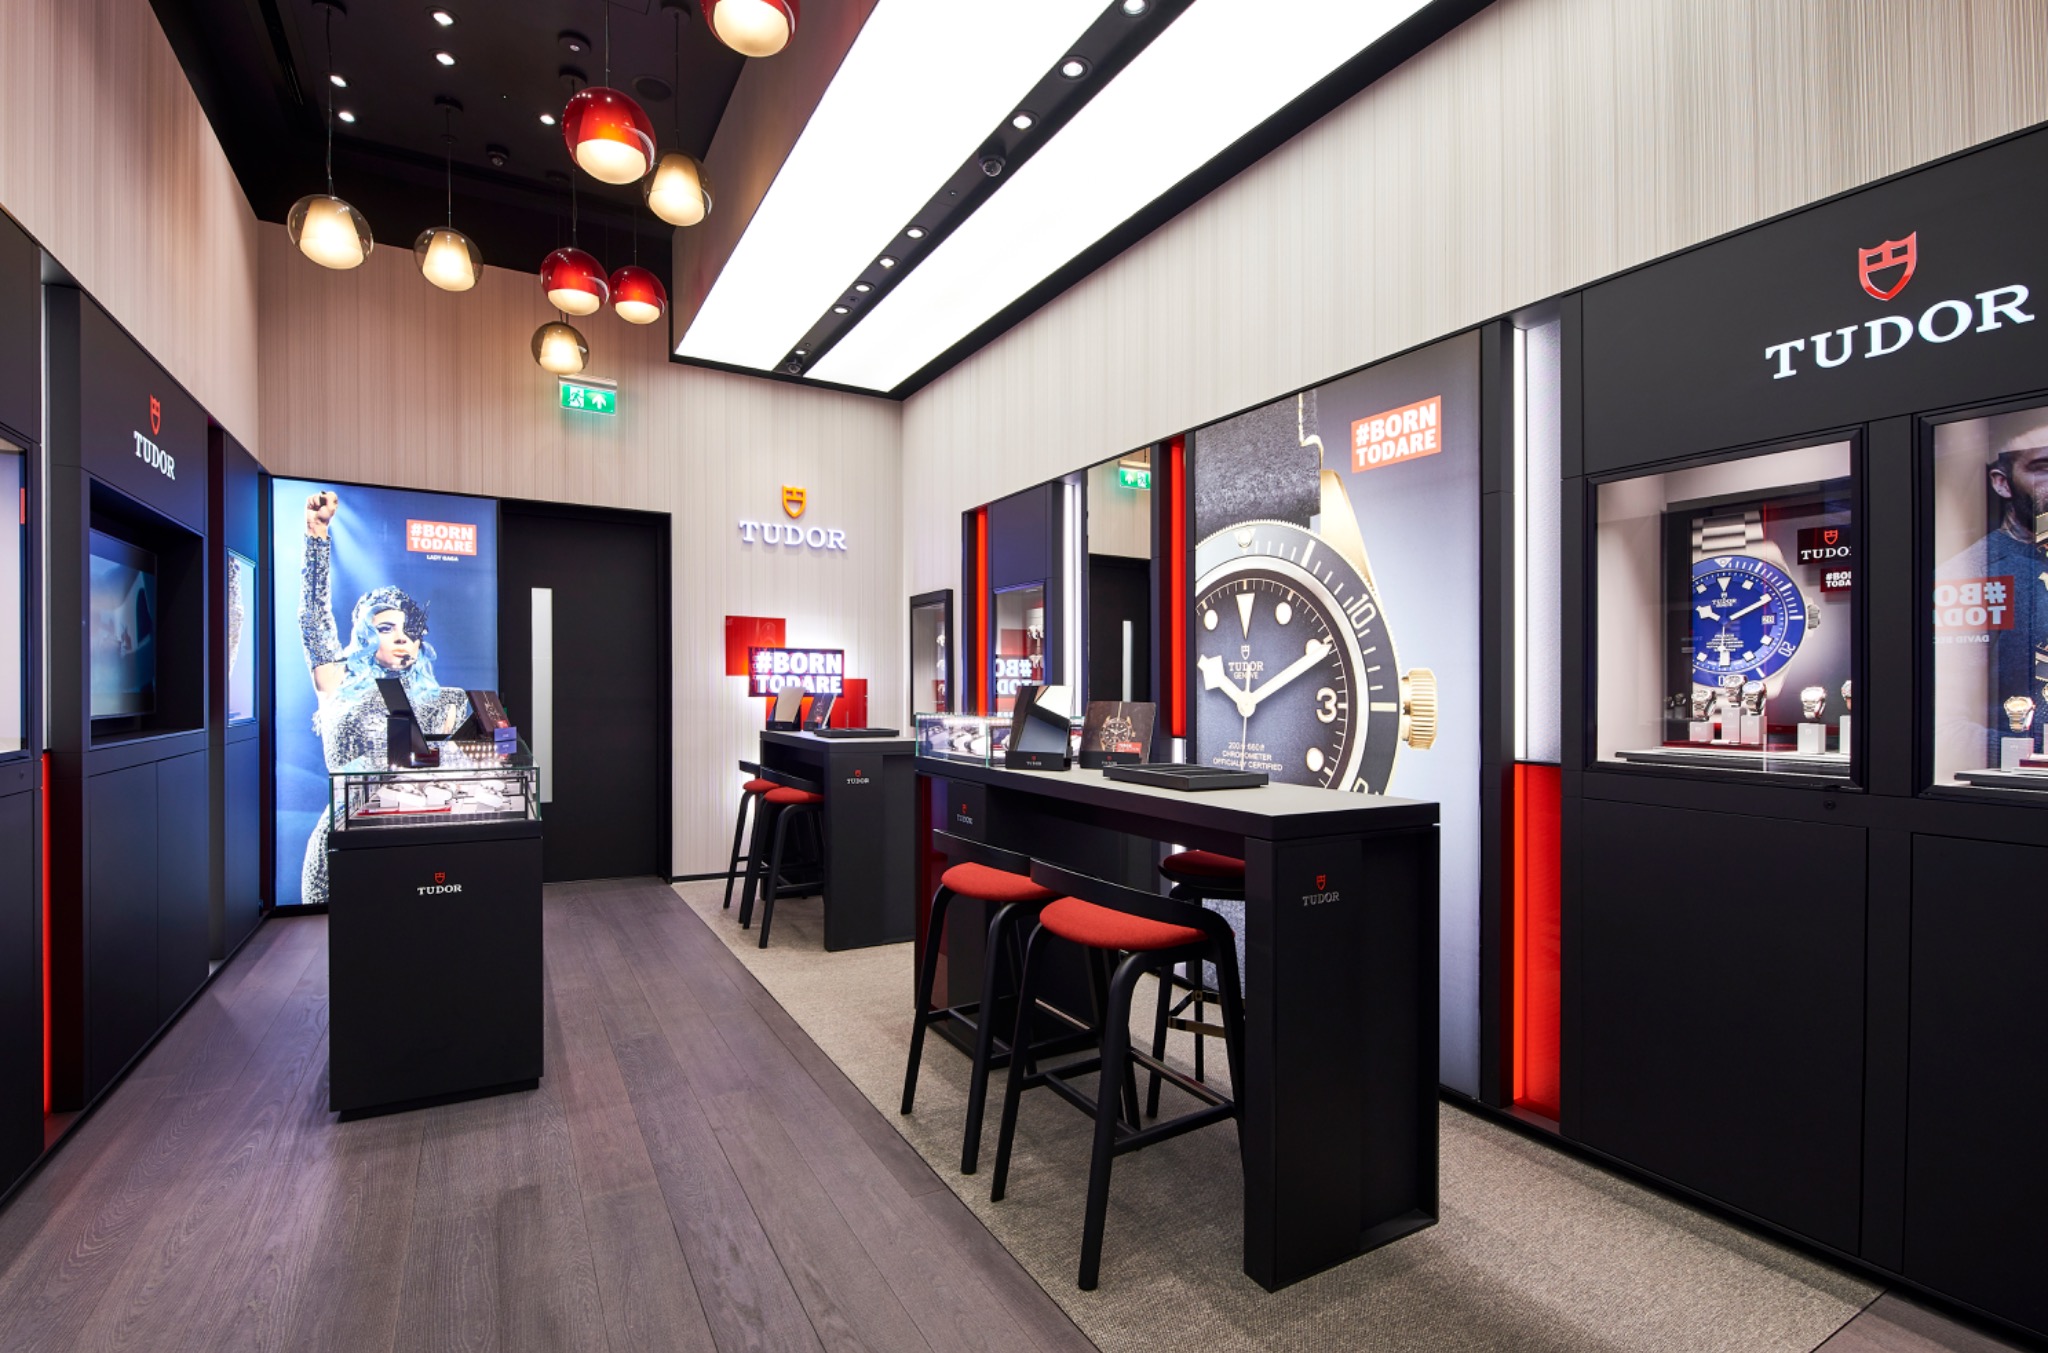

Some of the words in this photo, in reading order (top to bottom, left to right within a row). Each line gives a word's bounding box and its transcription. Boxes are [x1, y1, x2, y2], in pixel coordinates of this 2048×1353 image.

[1765, 284, 2035, 379] TUDOR
[1355, 402, 1437, 447] #BORN
[133, 430, 175, 481] TUDOR
[1356, 428, 1437, 467] TODARE
[410, 523, 473, 541] #BORN
[739, 520, 847, 551] TUDOR
[411, 537, 473, 553] TODARE
[1800, 546, 1852, 560] TUDO
[1346, 593, 1377, 630] 10
[755, 651, 843, 674] #BORN
[1228, 661, 1264, 671] TUDOR
[1233, 671, 1259, 680] GENVE
[1316, 687, 1338, 724] 3
[416, 883, 463, 896] TUDOR
[1302, 890, 1341, 907] TUDOR
